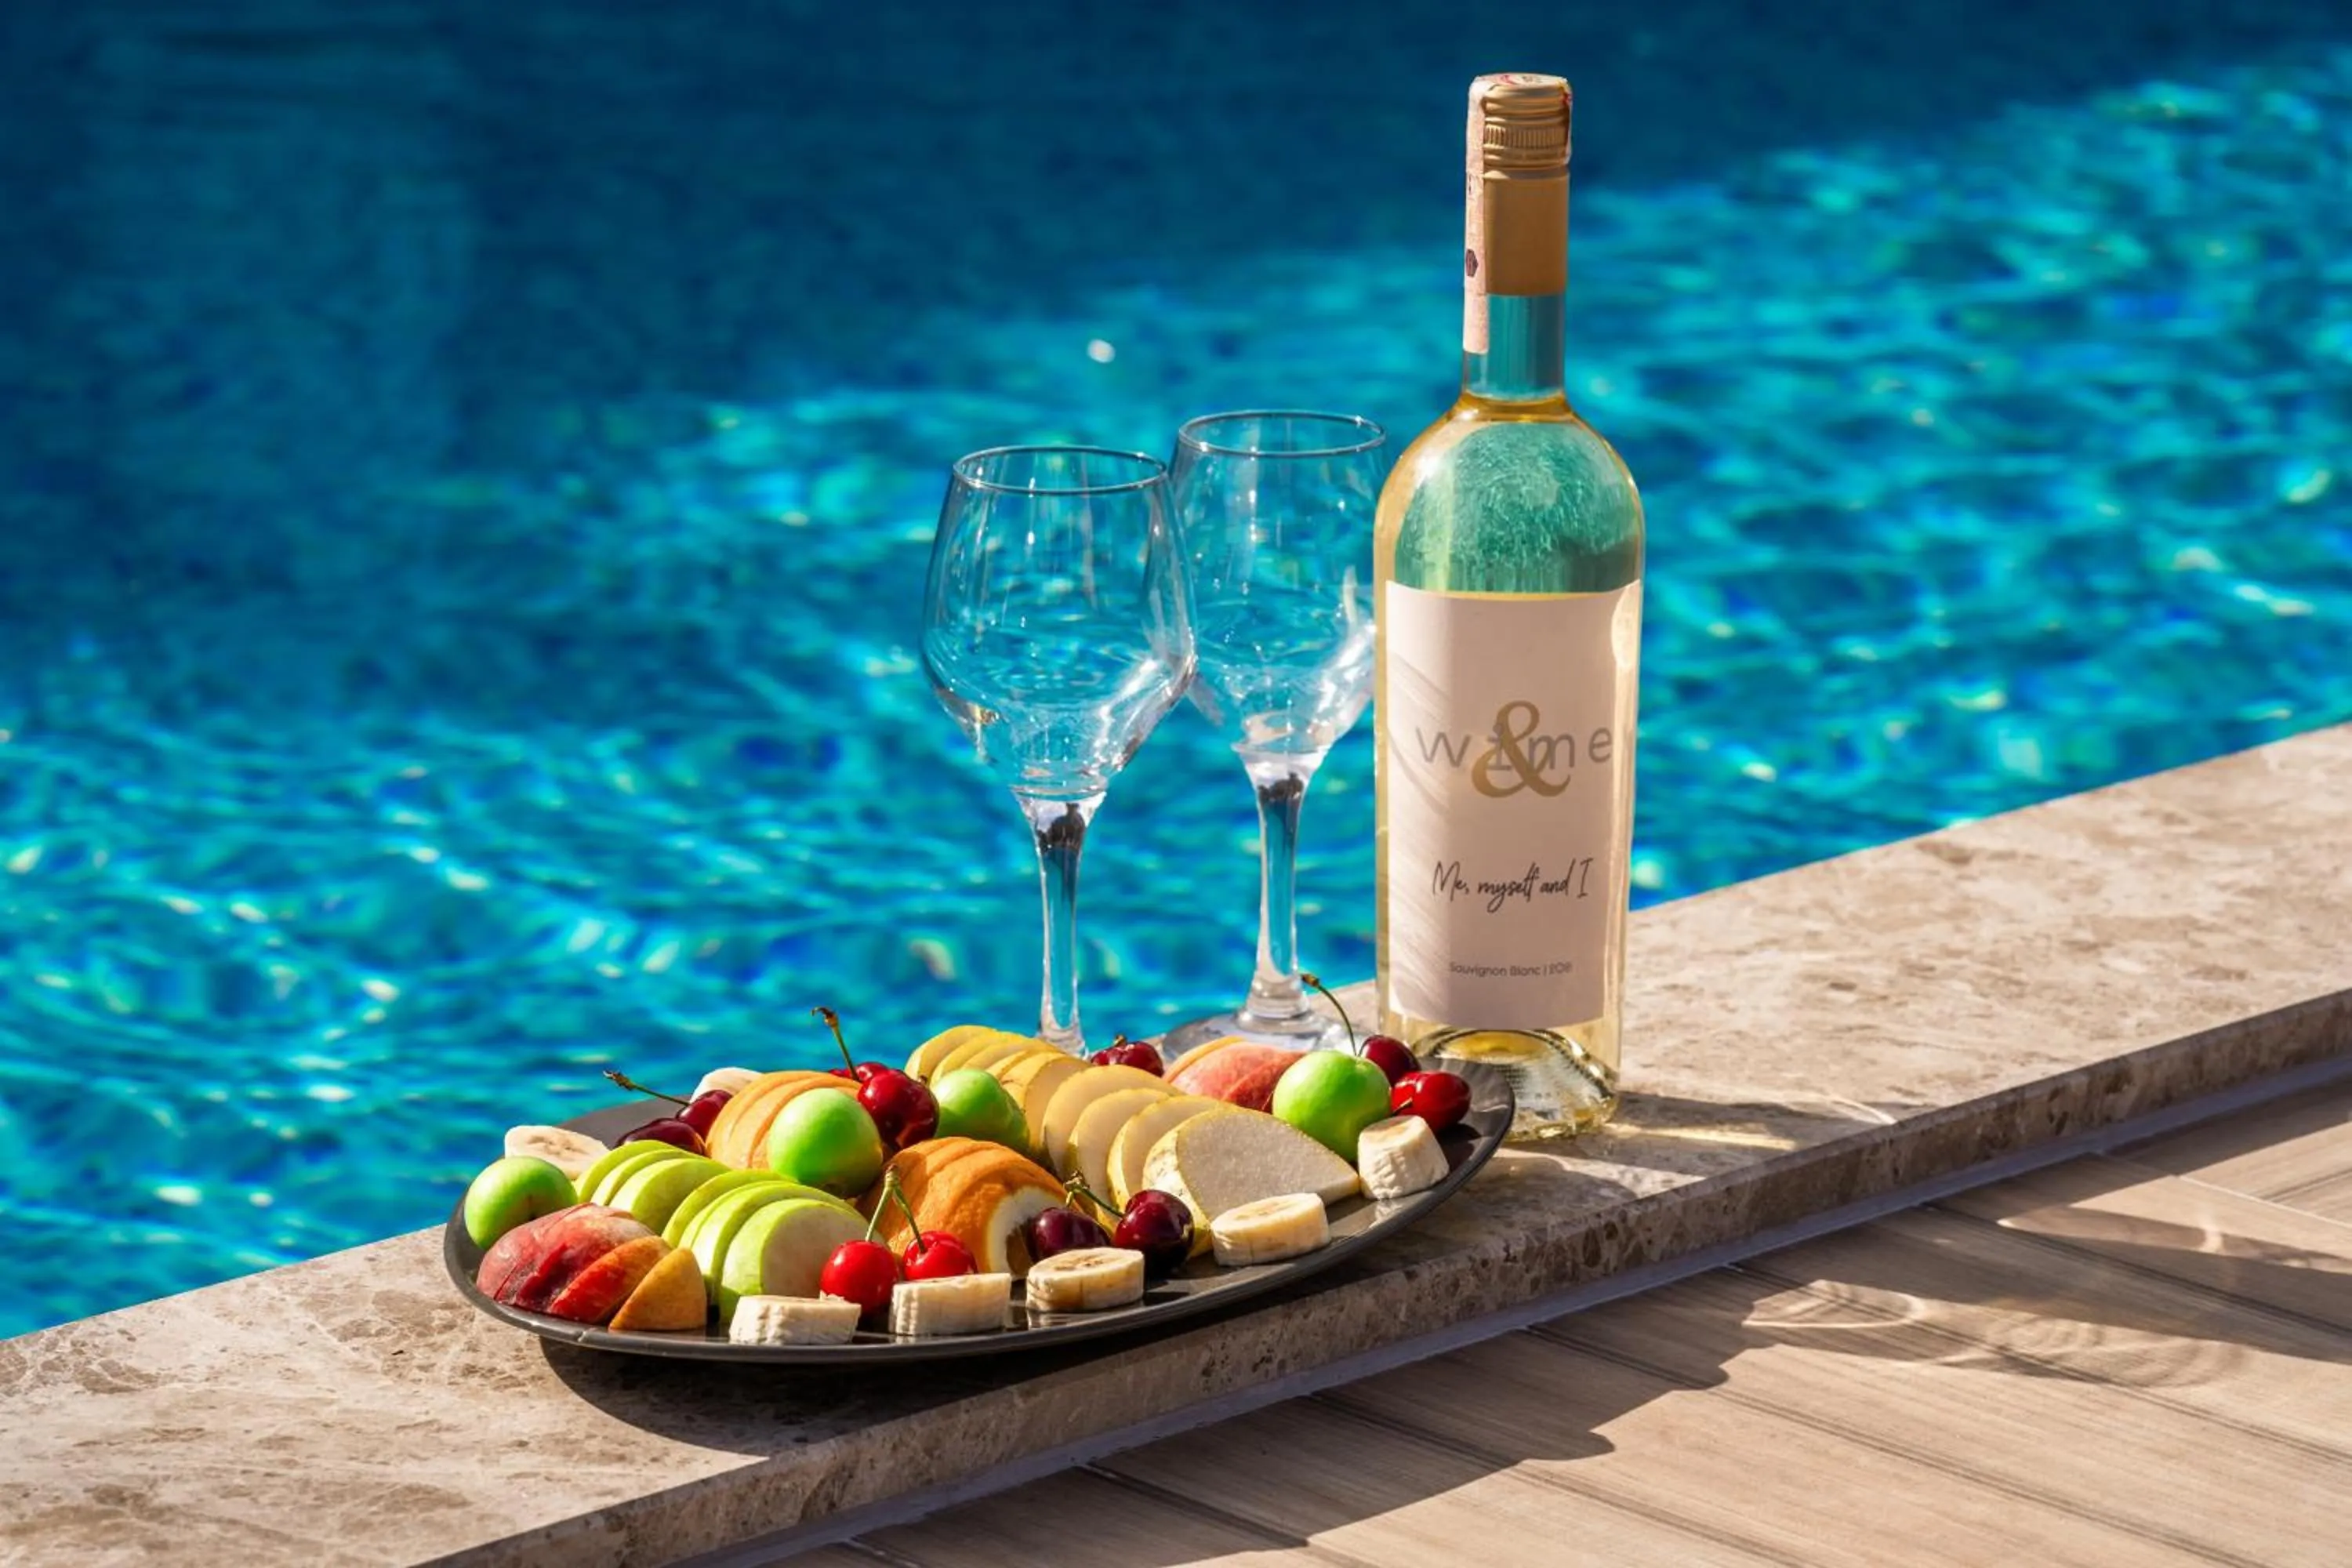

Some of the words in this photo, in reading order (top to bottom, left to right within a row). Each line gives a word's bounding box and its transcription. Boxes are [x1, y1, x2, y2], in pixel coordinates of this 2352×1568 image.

[1432, 860, 1469, 902] Me,
[1478, 862, 1540, 913] myself
[1540, 858, 1576, 895] and
[1577, 858, 1594, 898] I
[1450, 961, 1508, 977] Sauvignon
[1509, 964, 1541, 977] Blanc
